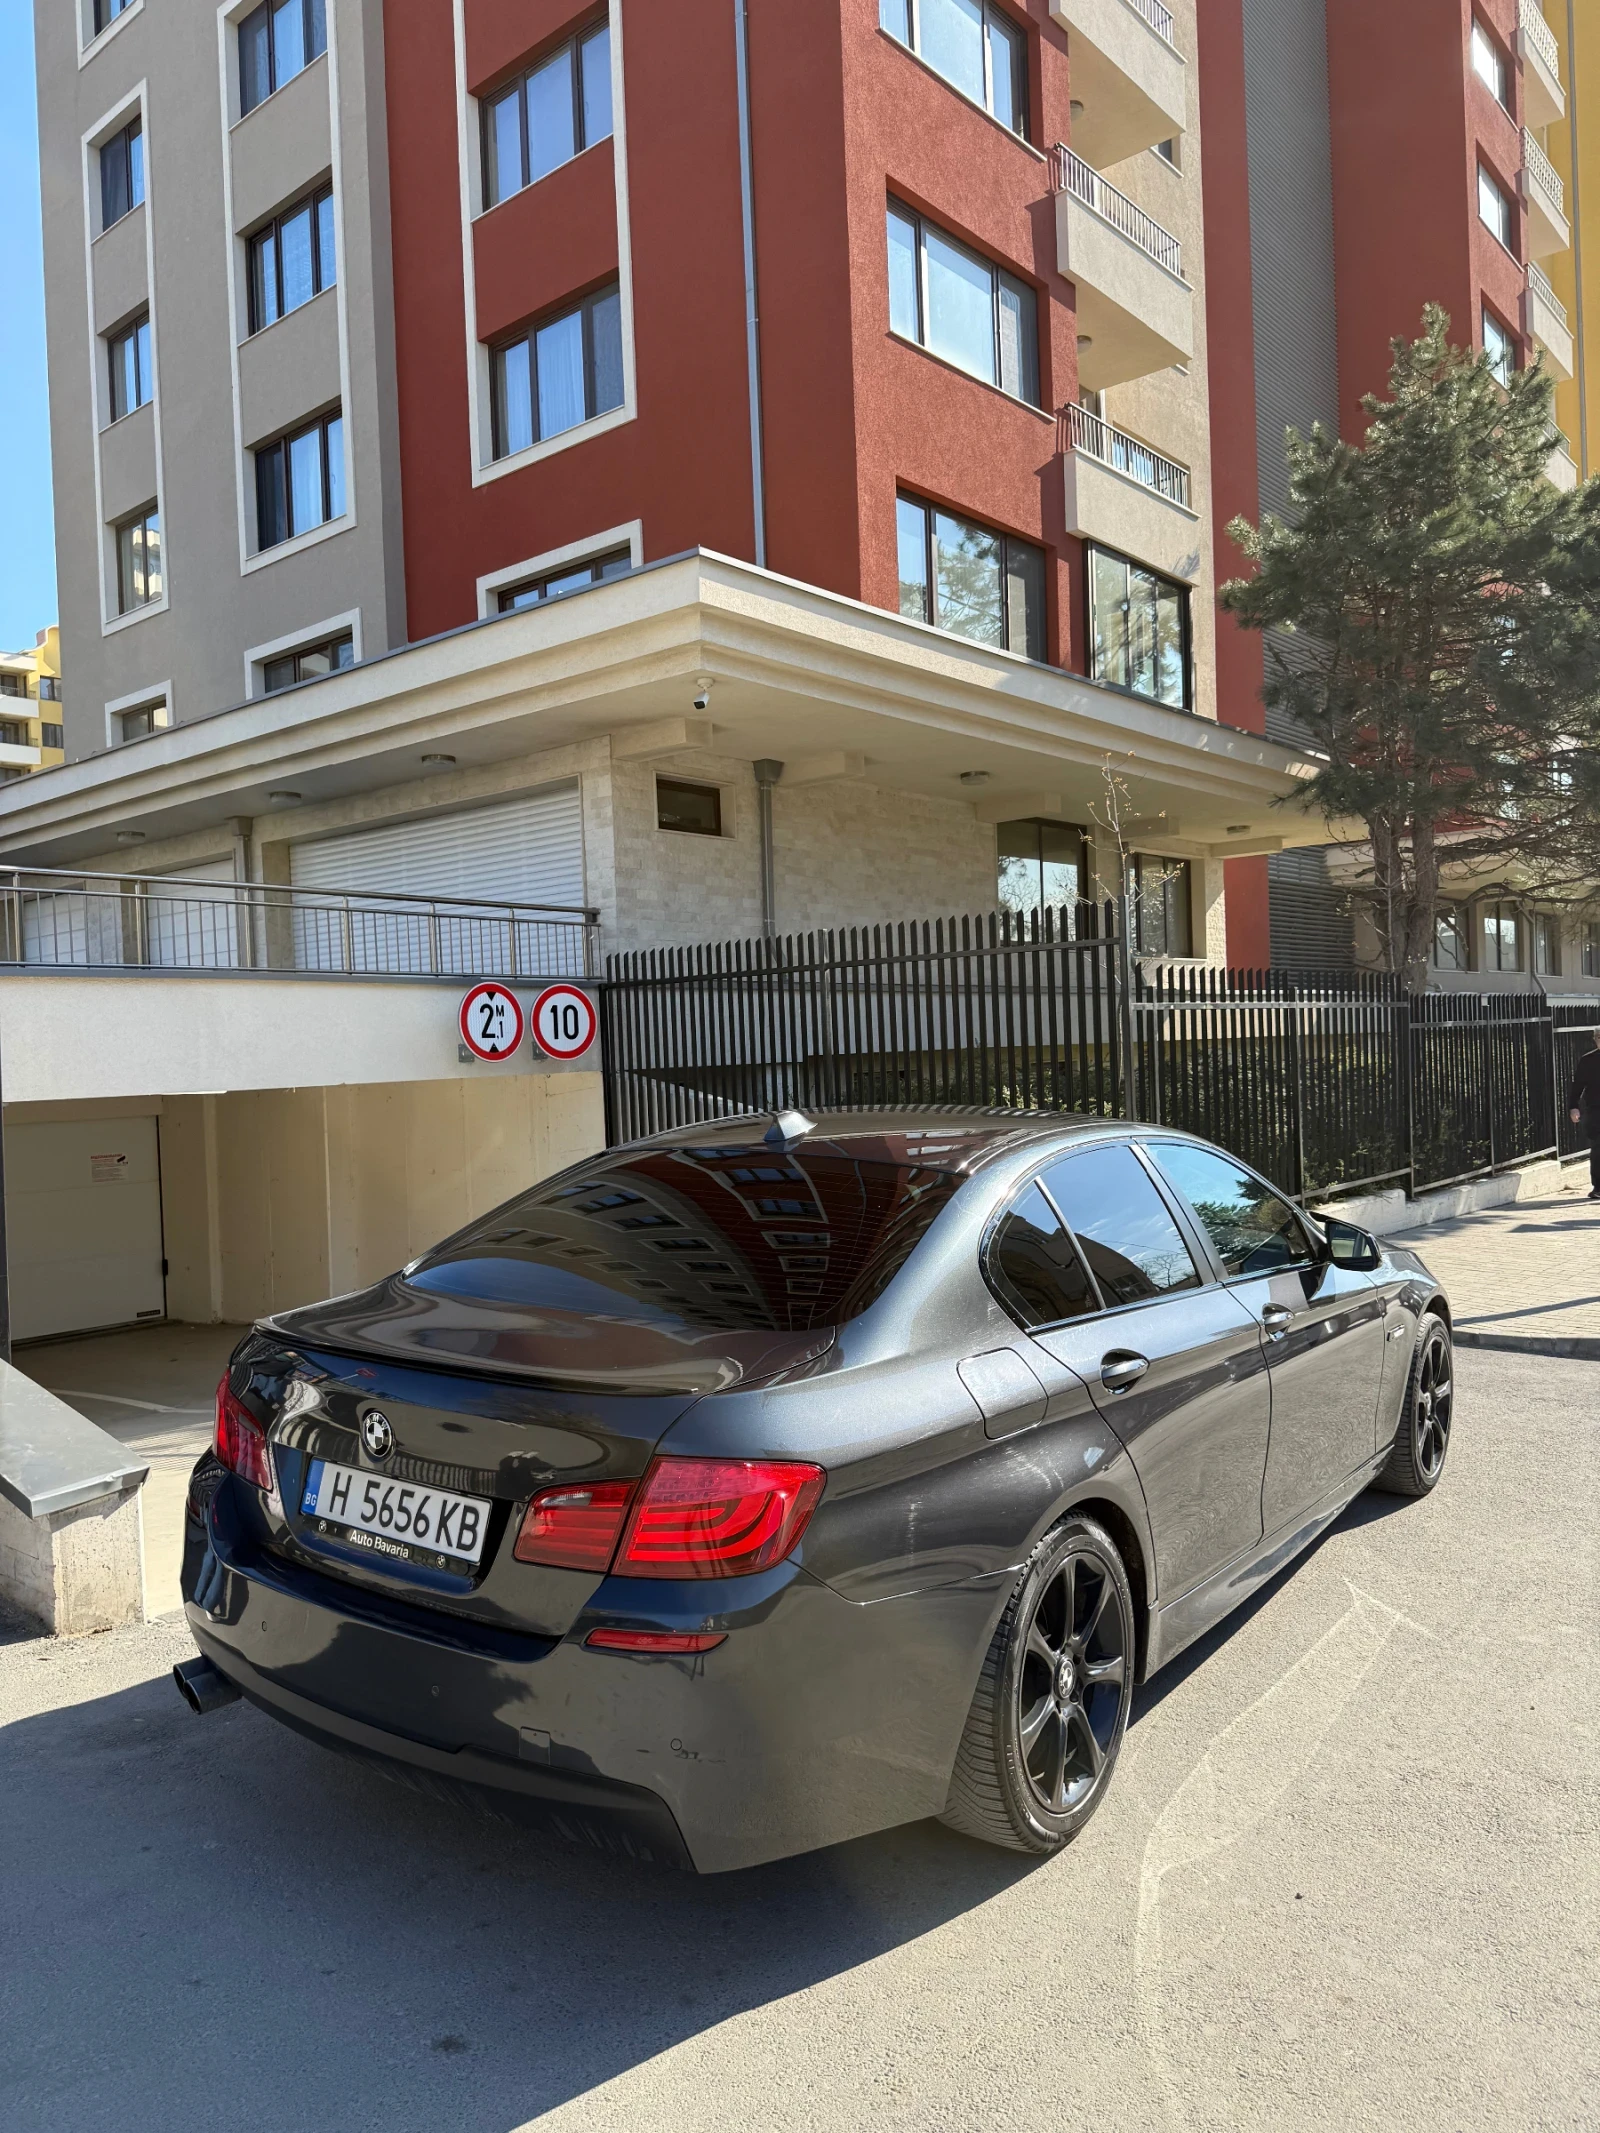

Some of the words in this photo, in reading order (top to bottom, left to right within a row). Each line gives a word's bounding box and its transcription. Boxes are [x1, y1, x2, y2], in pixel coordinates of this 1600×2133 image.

[550, 1004, 580, 1040] 10
[304, 1492, 318, 1507] BG
[328, 1471, 353, 1517] H
[360, 1479, 431, 1539] 5656
[435, 1499, 480, 1552] KB
[349, 1529, 373, 1548] Auto
[374, 1536, 409, 1559] Bavaria
